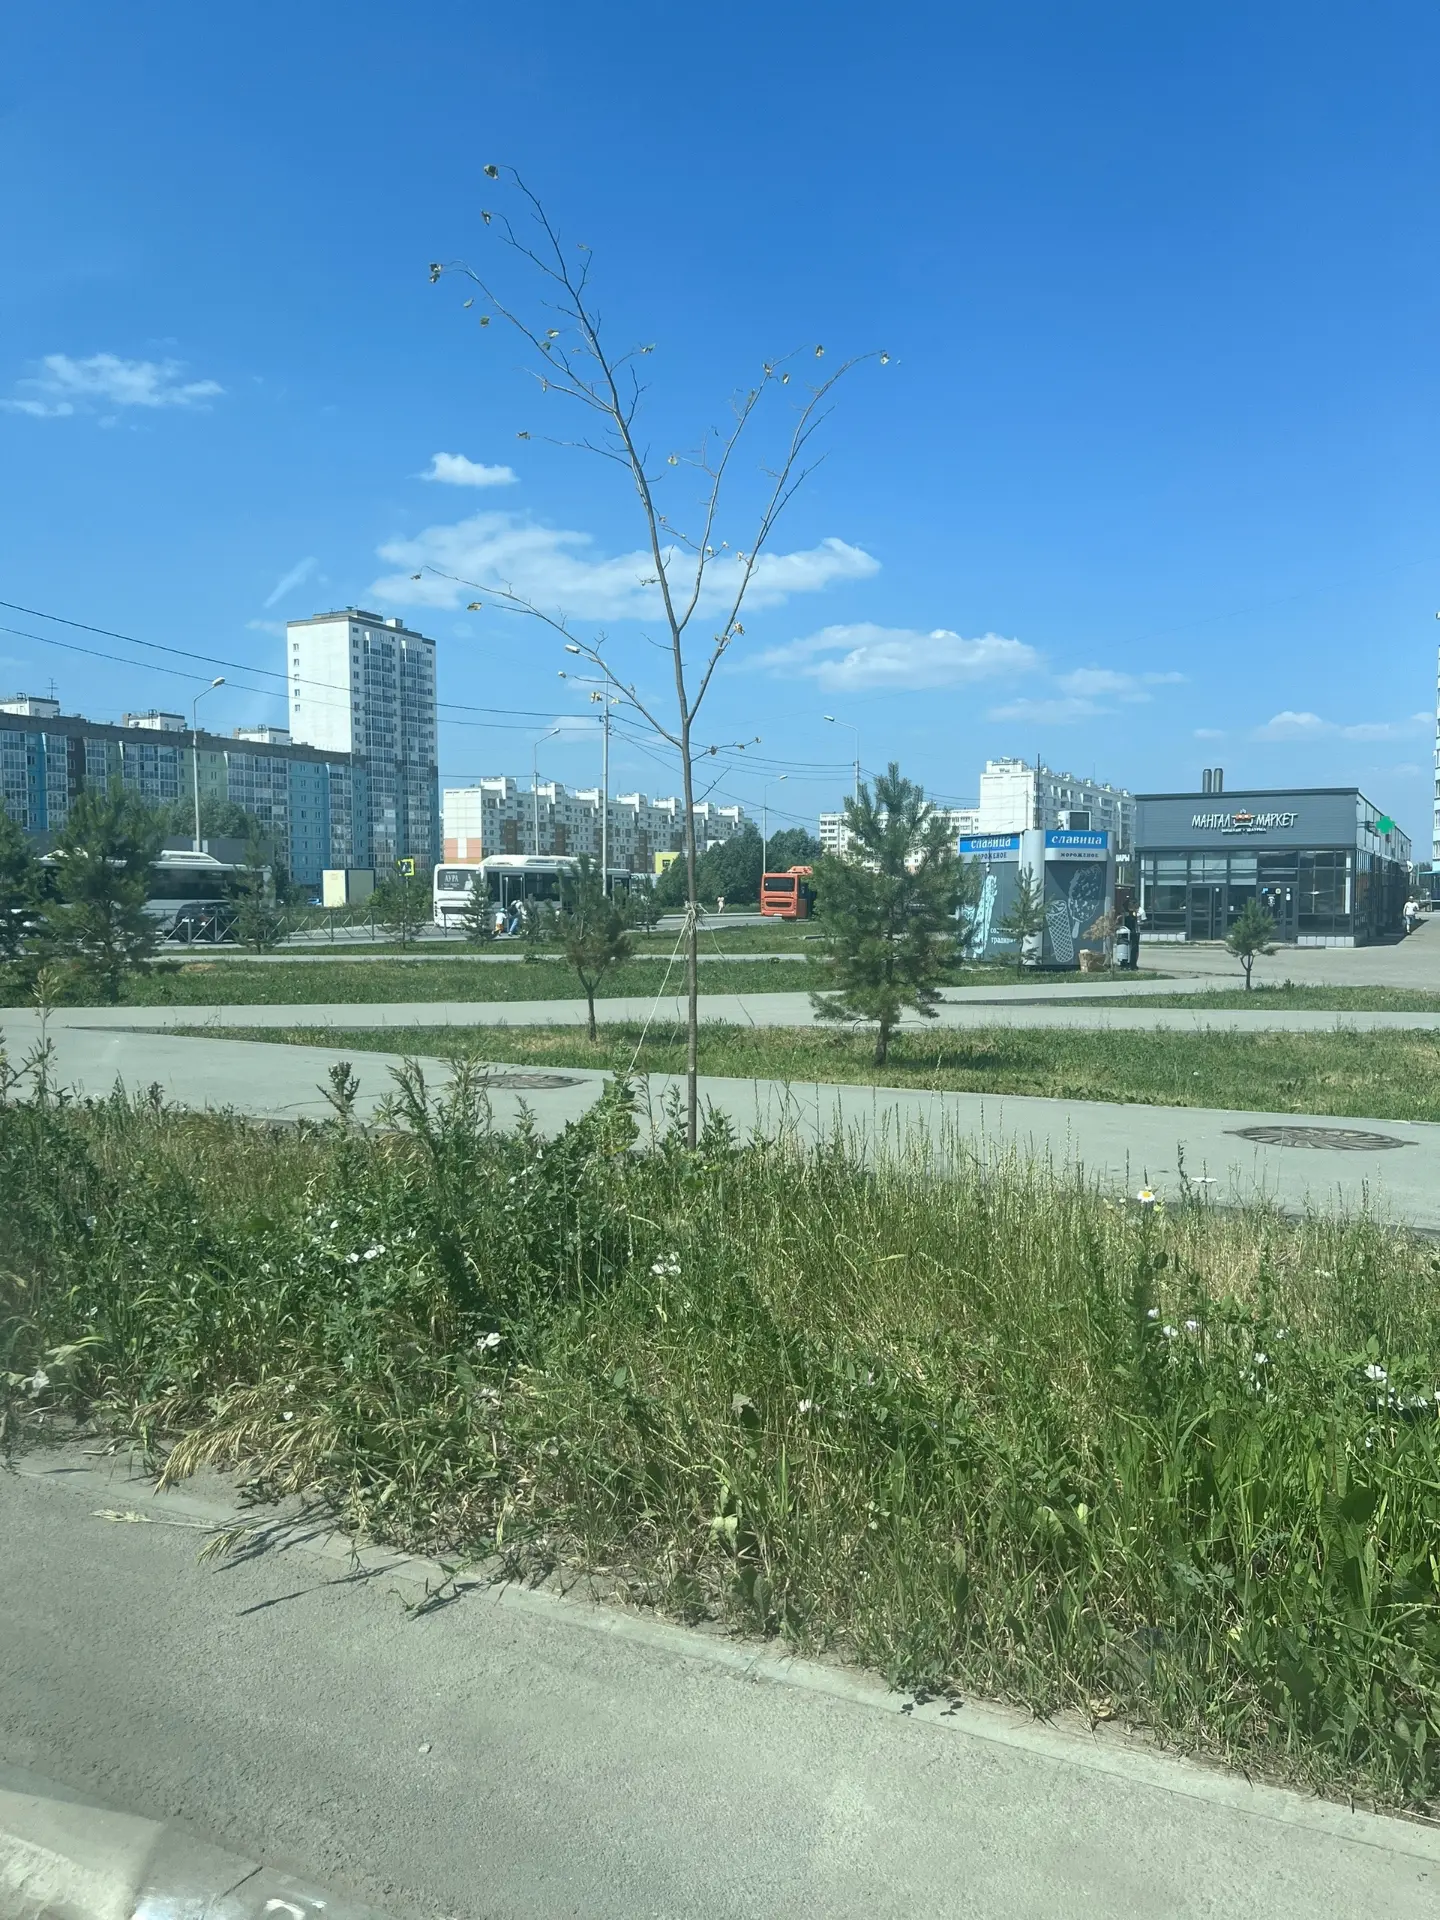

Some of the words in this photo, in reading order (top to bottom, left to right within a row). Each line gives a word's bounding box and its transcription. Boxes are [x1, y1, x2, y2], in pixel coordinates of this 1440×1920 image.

[1191, 813, 1231, 828] МАНГАЛ
[1256, 812, 1298, 827] МАРКЕТ
[1051, 835, 1102, 845] славица
